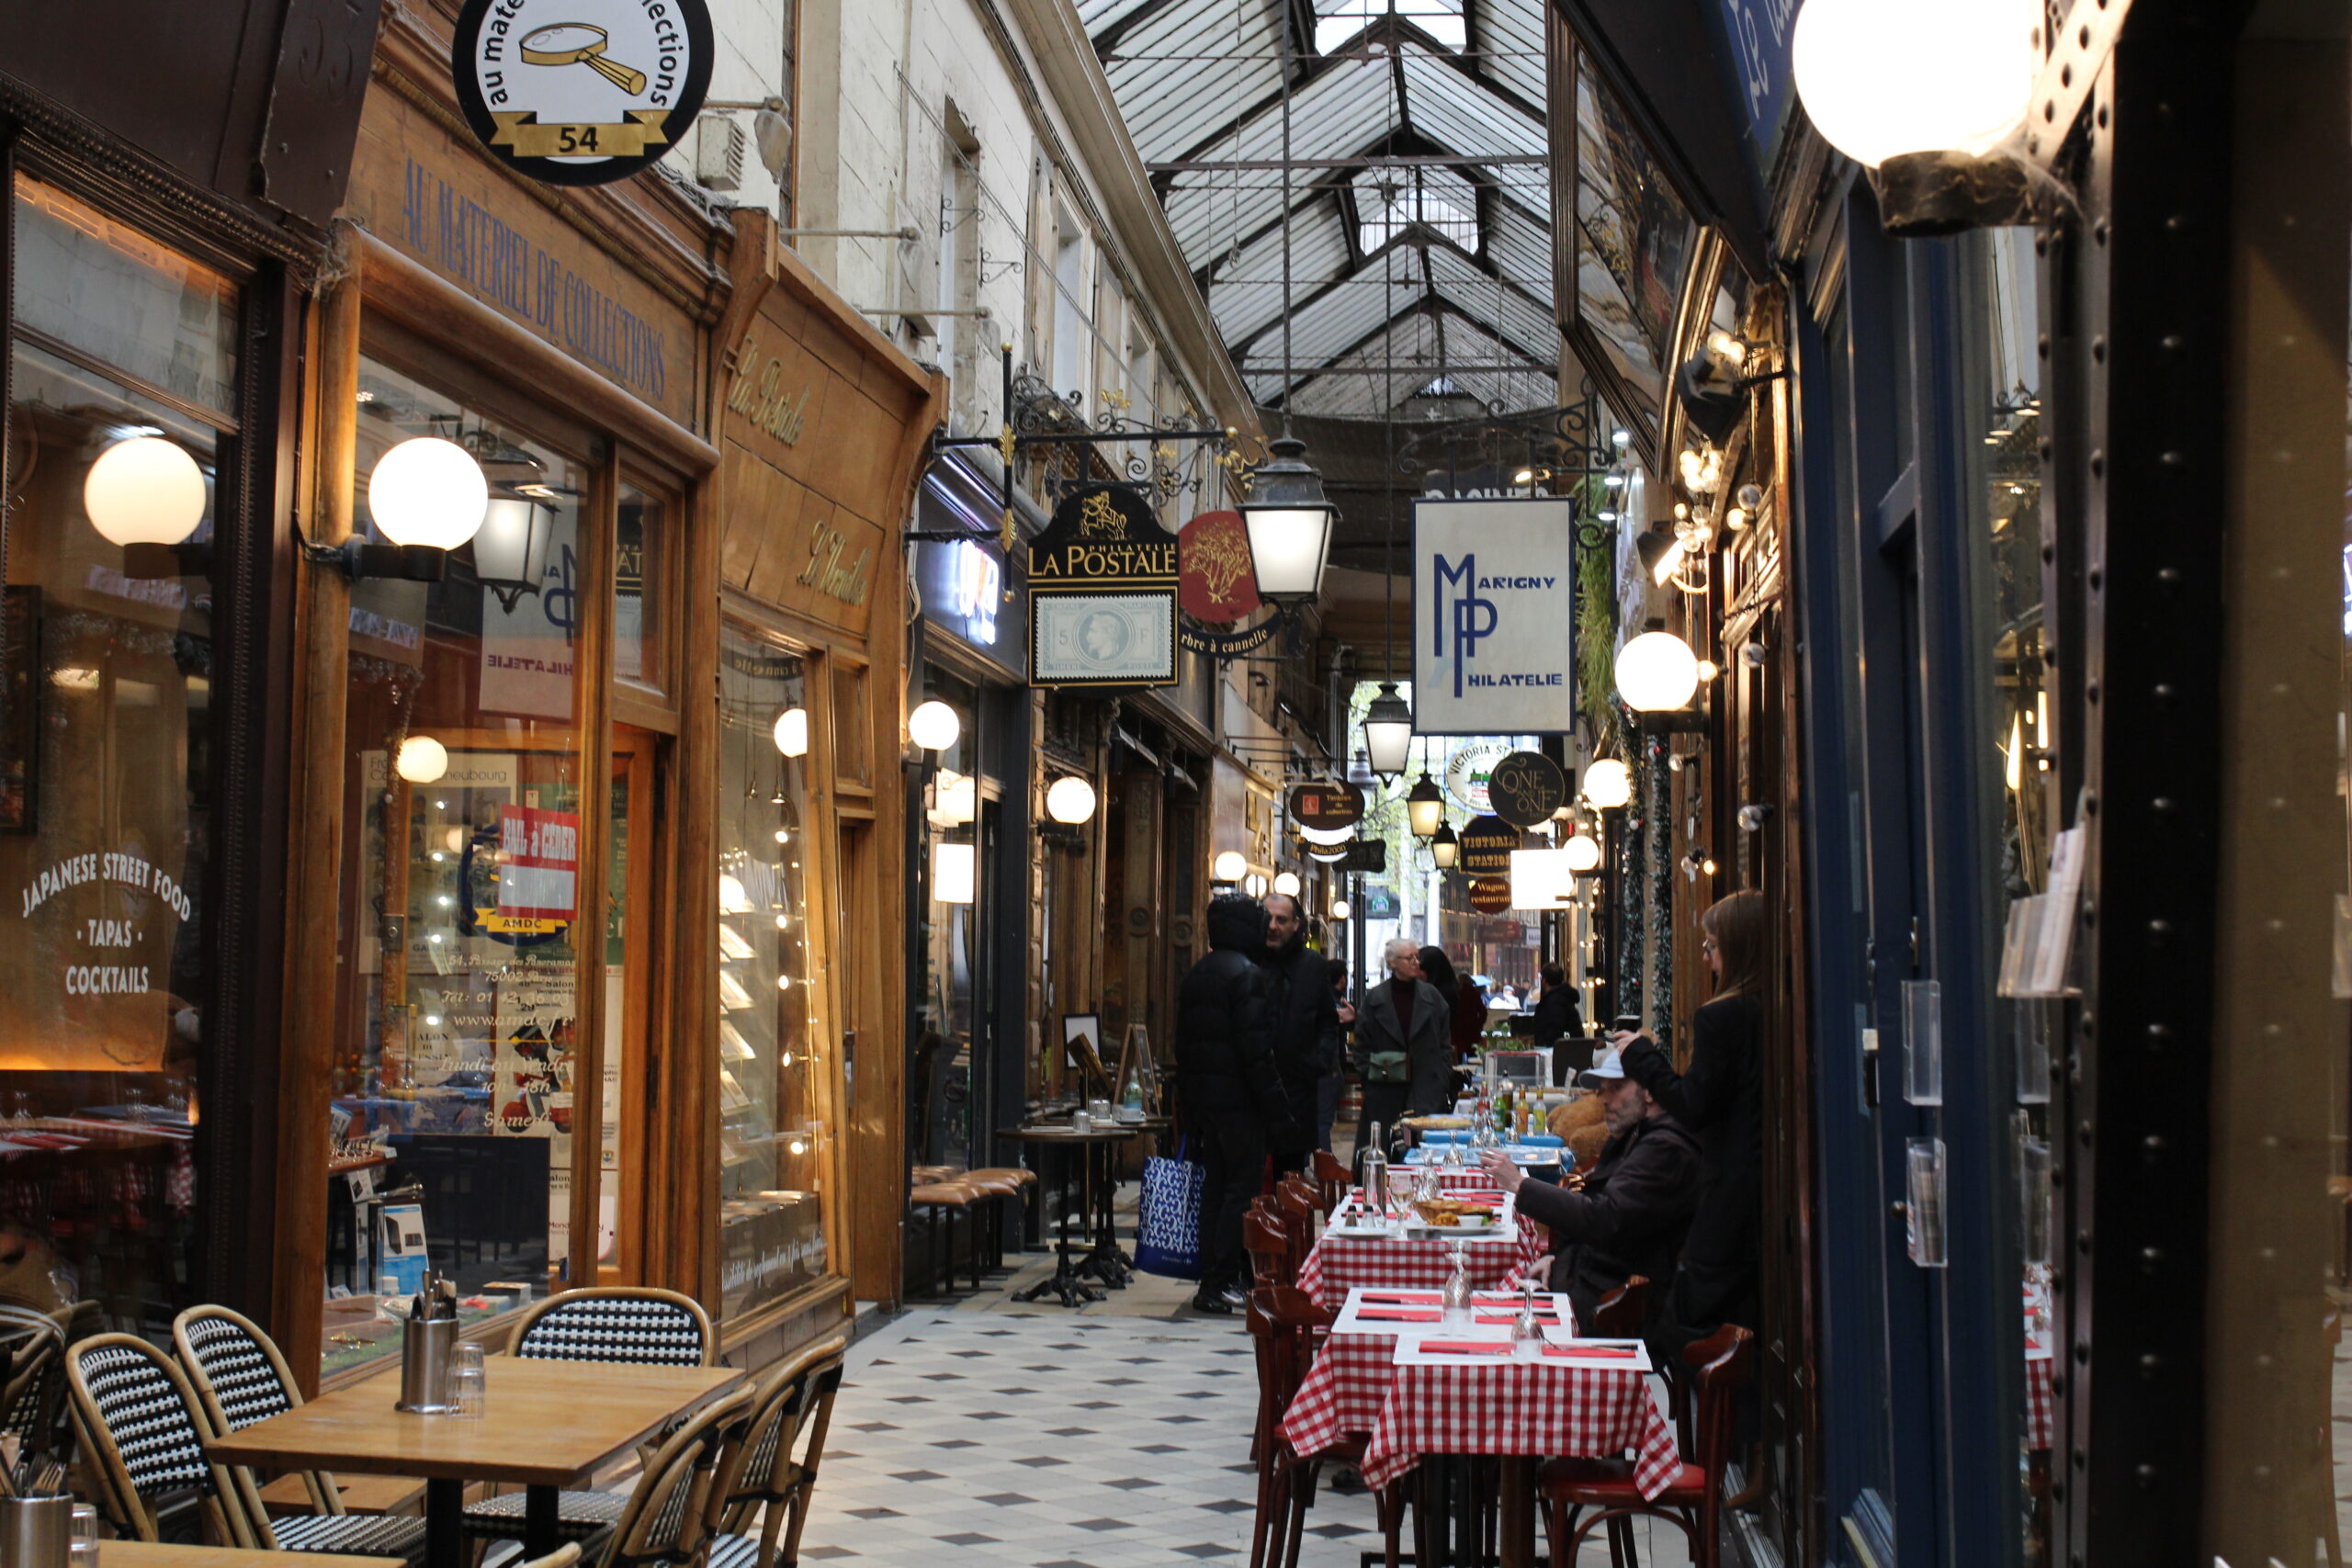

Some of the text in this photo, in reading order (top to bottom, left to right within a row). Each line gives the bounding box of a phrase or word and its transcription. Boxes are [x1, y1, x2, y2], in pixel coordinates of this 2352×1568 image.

[483, 0, 684, 107] au mate ections
[559, 127, 599, 152] 54
[400, 158, 665, 401] AU MATERIEL DE COLLECTIONS
[1089, 543, 1176, 552] PHILATELIE
[1028, 545, 1176, 577] LA POSTALE
[1059, 629, 1069, 646] 5
[1181, 628, 1268, 654] rbre à cannelle
[1450, 744, 1490, 775] VICTORIA
[1501, 770, 1545, 795] ONE
[530, 820, 539, 858] à
[1464, 835, 1517, 849] VICTORIA
[22, 852, 191, 922] JAPANESE STREET FOOD
[1477, 882, 1506, 893] Wagon
[1470, 894, 1510, 905] restauran
[502, 919, 542, 929] AMDC
[88, 919, 132, 948] TAPAS
[65, 964, 149, 995] COCKTAILS
[484, 970, 524, 983] 75002
[546, 980, 574, 988] Salon
[477, 992, 492, 1003] 01
[417, 1032, 449, 1041] ALON
[438, 1057, 488, 1073] Lundi
[549, 1174, 571, 1183] alon
